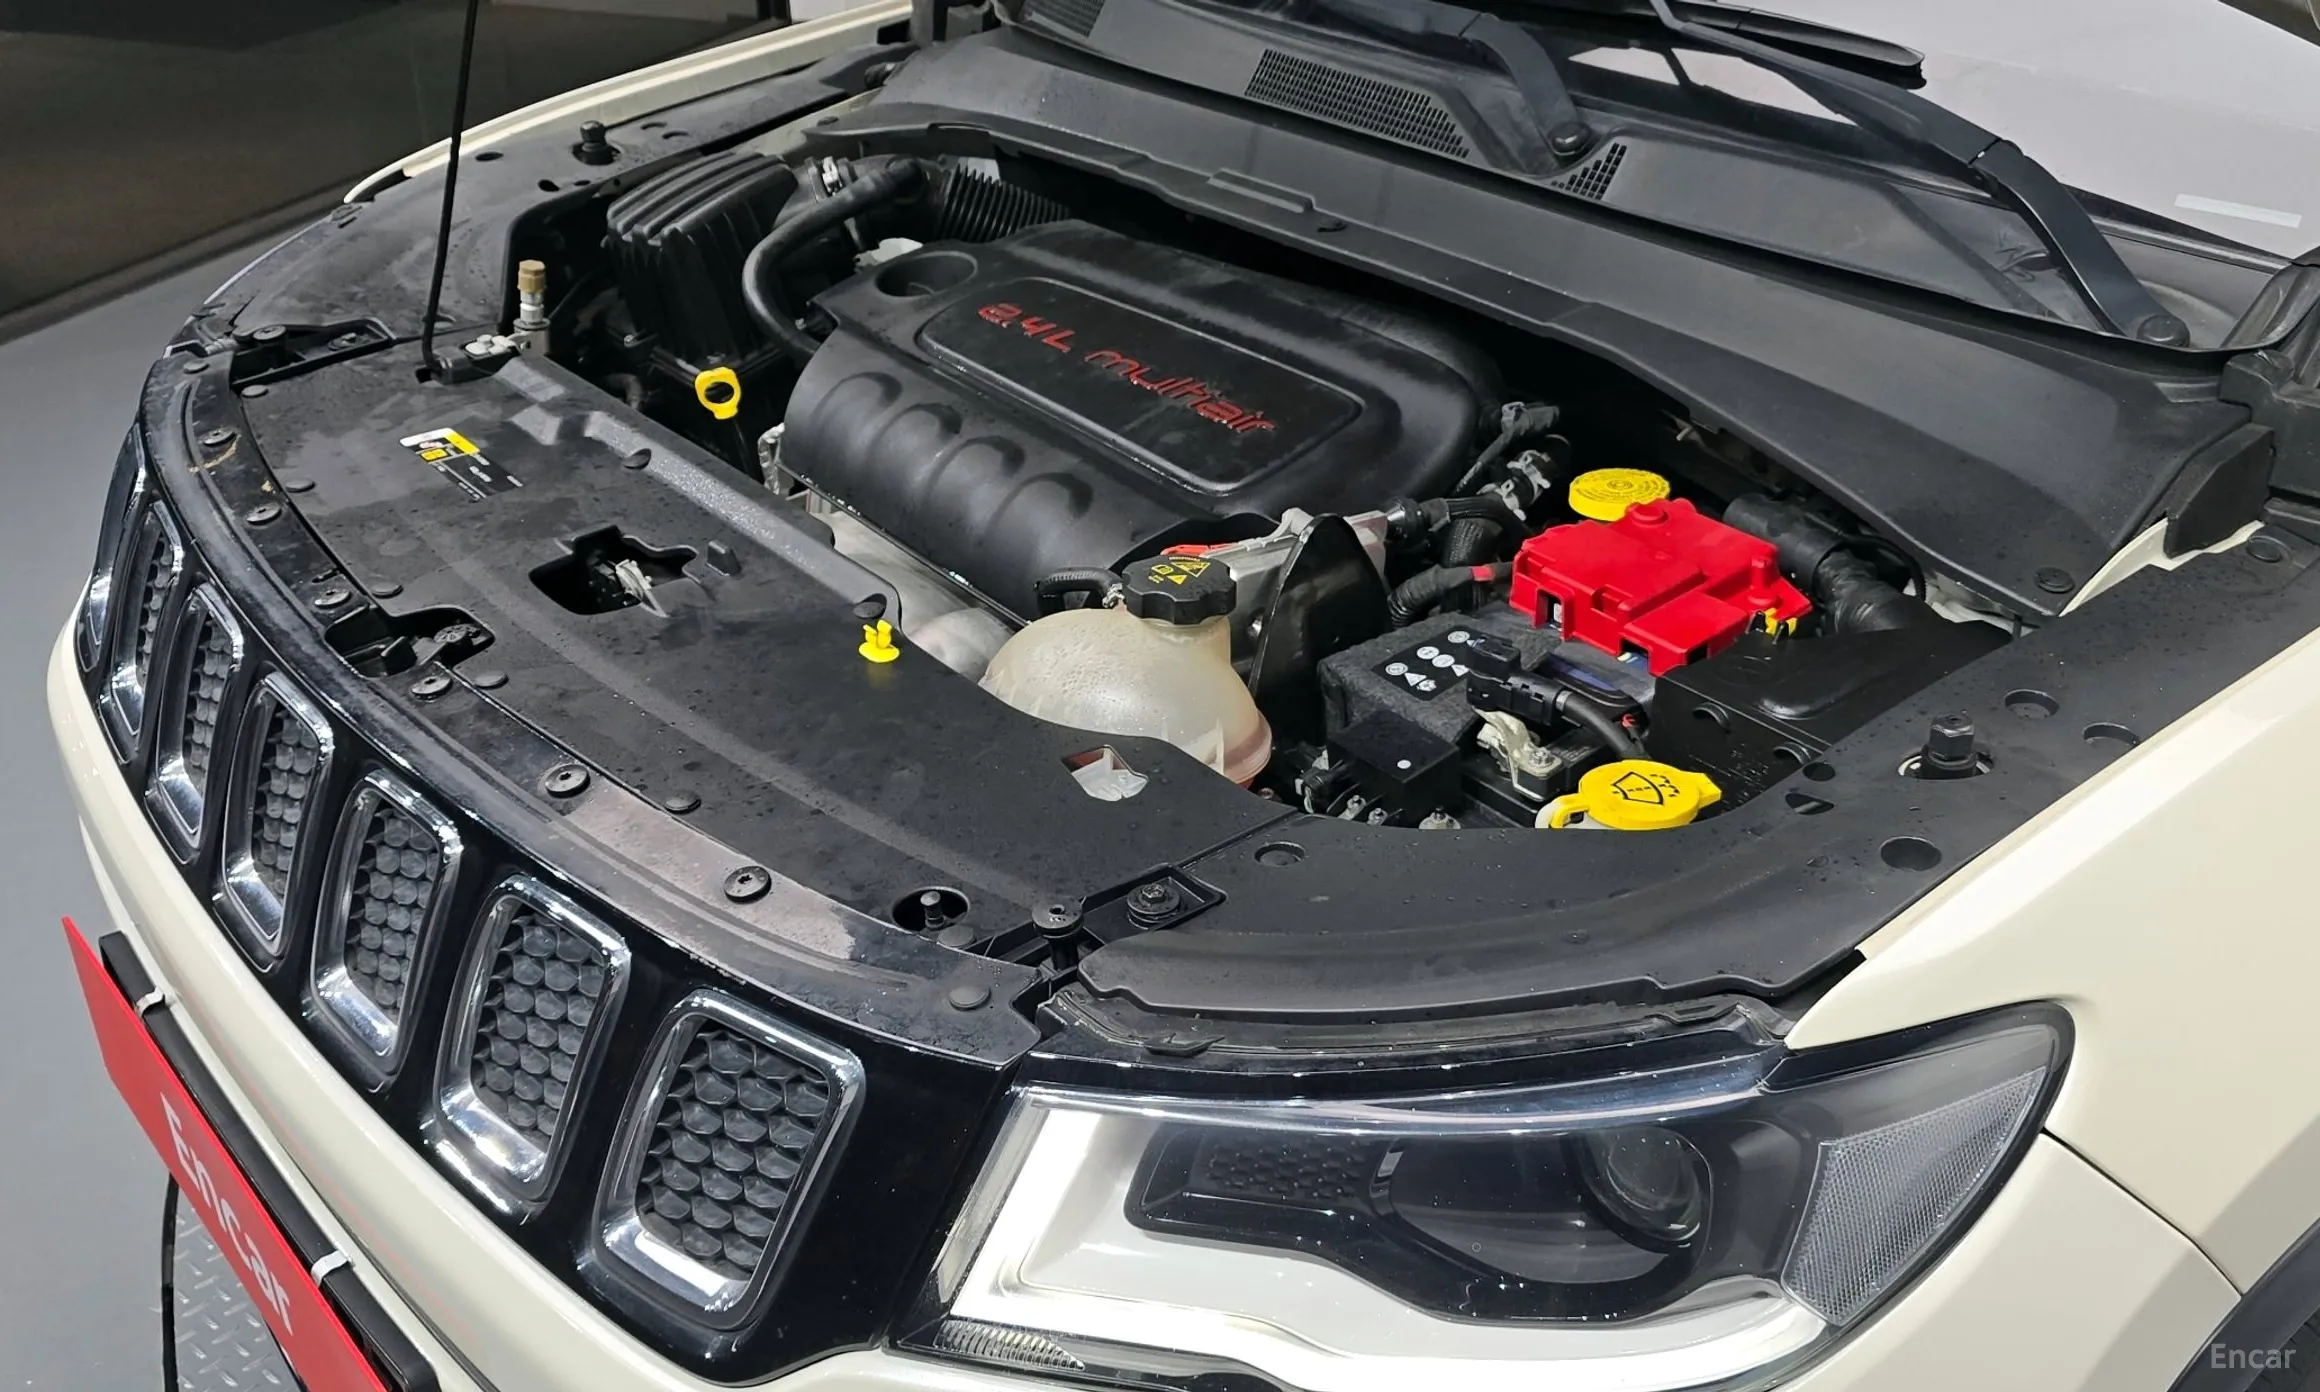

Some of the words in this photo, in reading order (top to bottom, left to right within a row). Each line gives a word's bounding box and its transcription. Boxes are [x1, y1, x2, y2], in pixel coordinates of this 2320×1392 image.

[978, 303, 1075, 353] 2.4L
[1084, 350, 1276, 433] multiair
[160, 1092, 293, 1336] Encar
